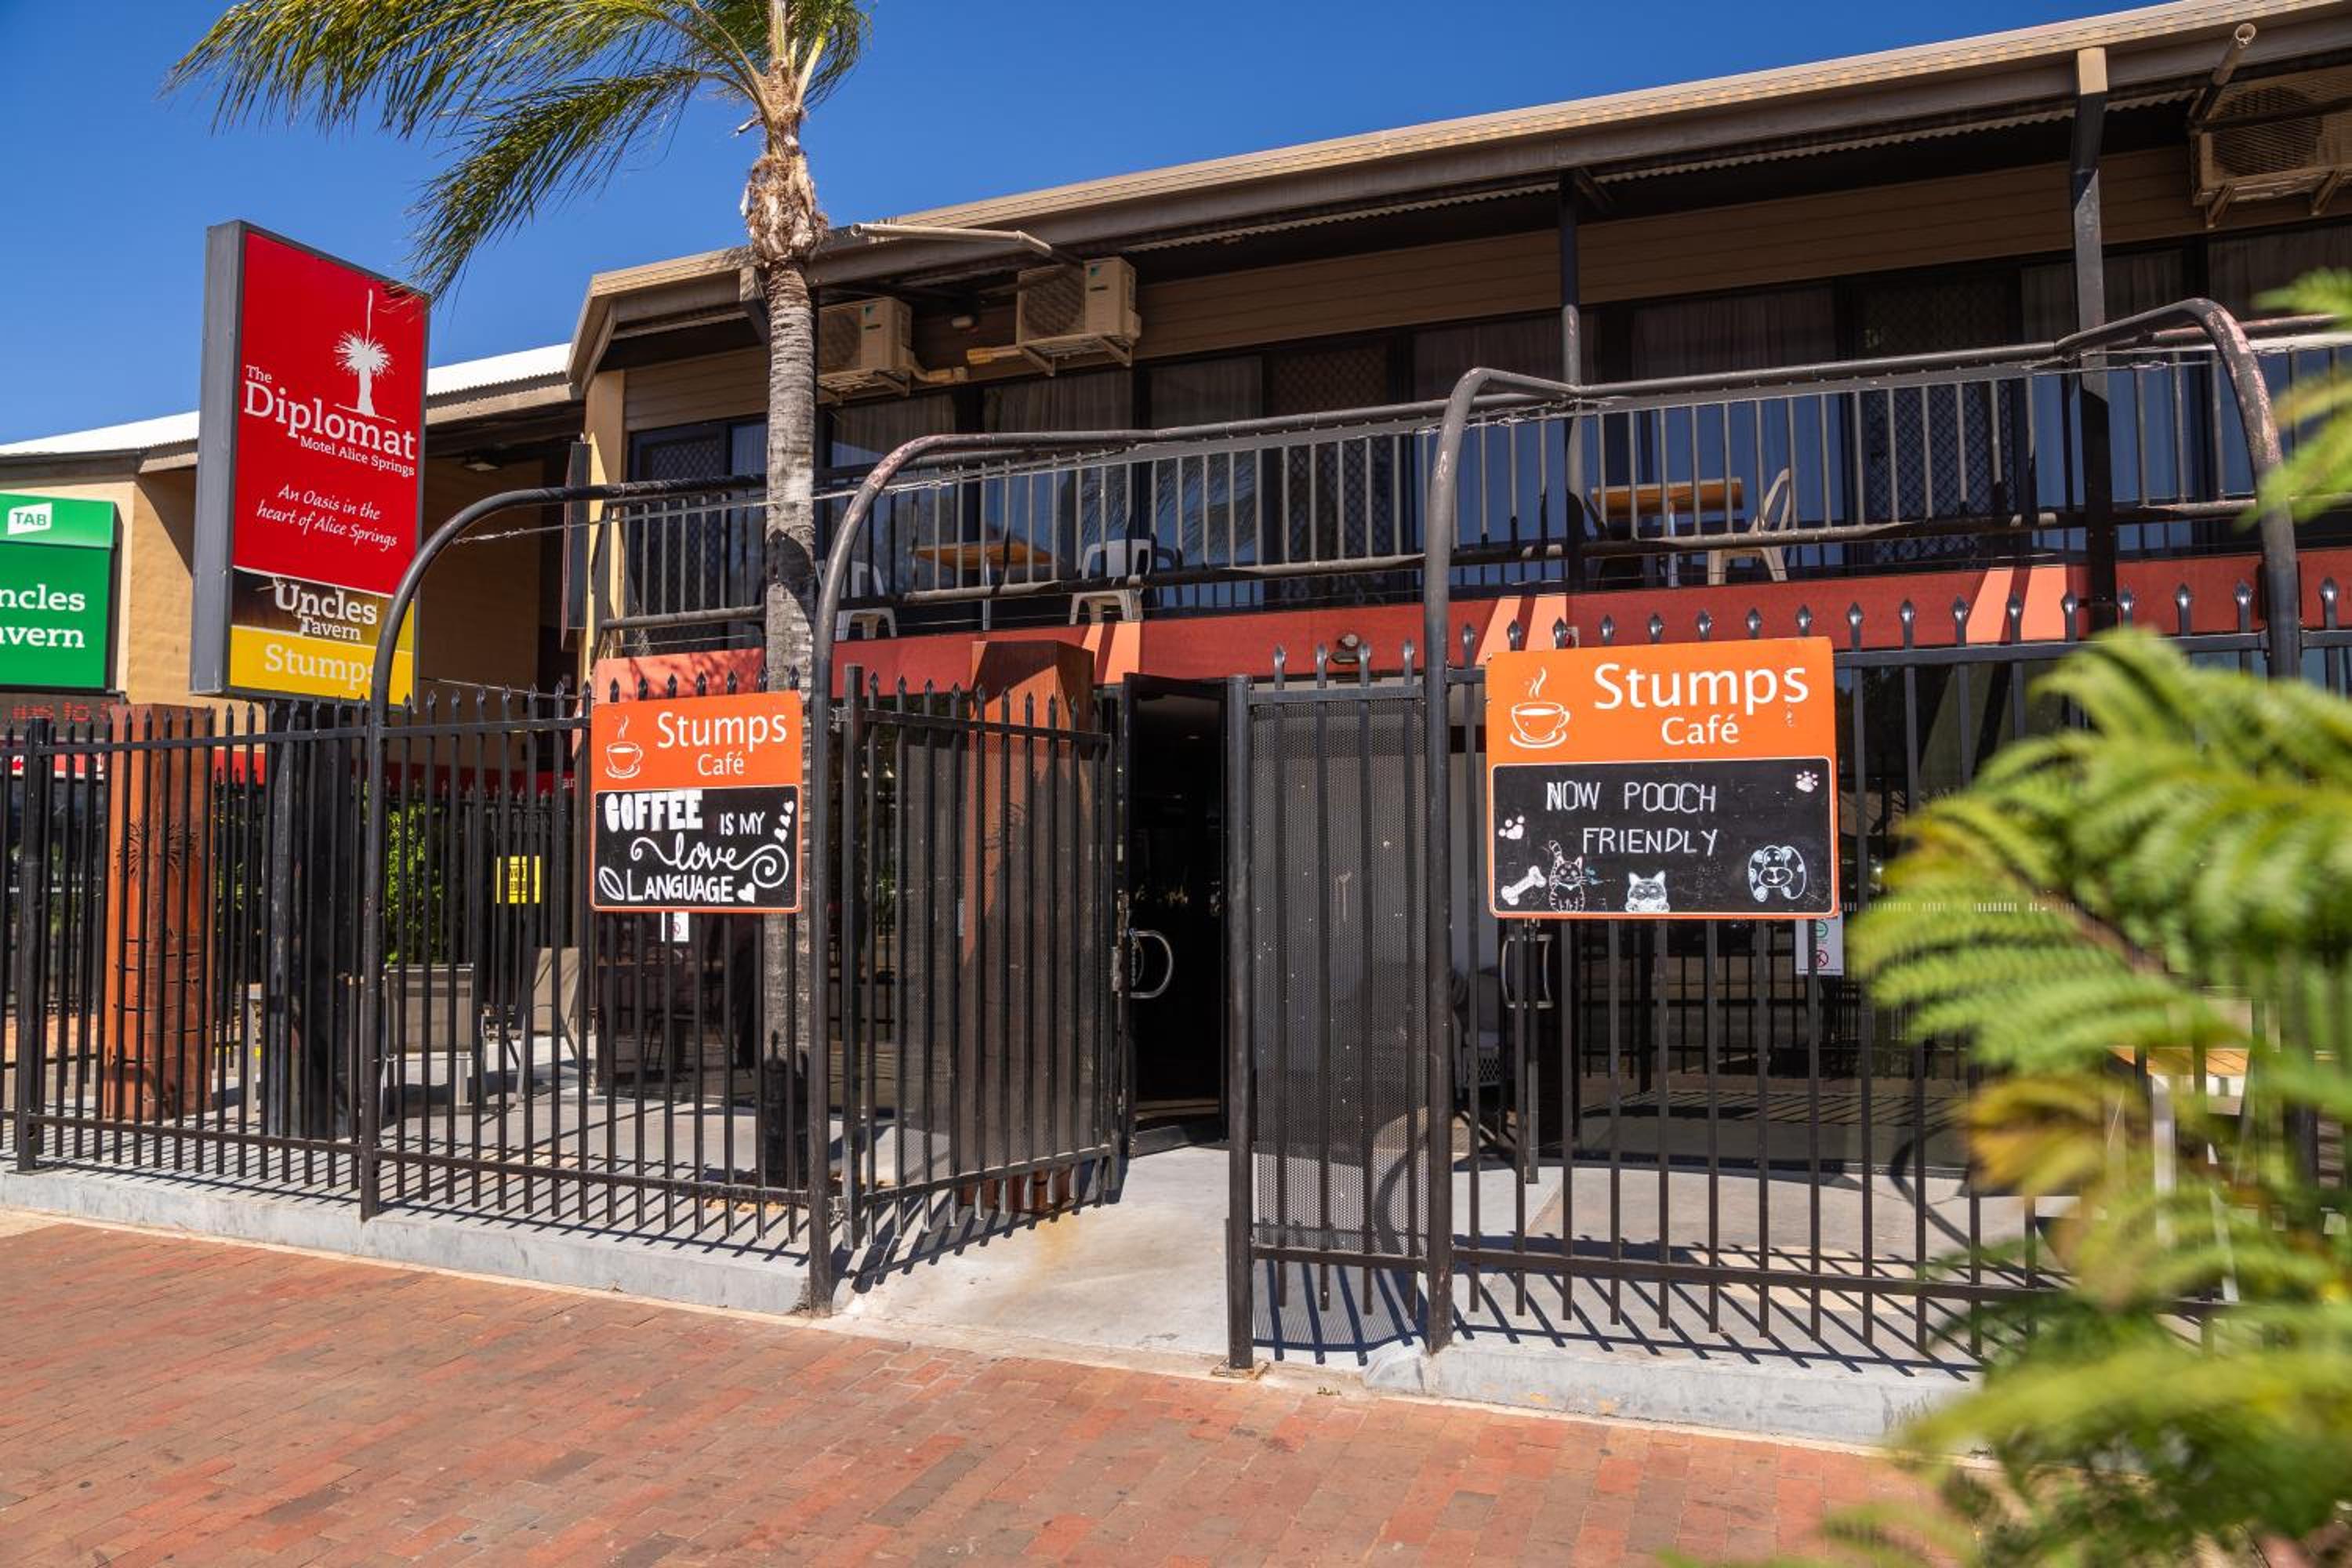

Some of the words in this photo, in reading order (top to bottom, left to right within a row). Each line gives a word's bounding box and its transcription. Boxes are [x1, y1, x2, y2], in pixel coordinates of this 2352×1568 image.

[245, 365, 272, 383] The
[244, 379, 416, 459] Diplomat
[300, 435, 336, 456] Motel
[338, 446, 368, 463] Alice
[371, 455, 415, 477] Springs
[13, 512, 47, 526] TAB
[278, 484, 299, 501] An
[303, 490, 339, 510] Oasis
[343, 499, 356, 515] in
[359, 501, 381, 521] the
[256, 499, 296, 524] heart
[299, 511, 315, 535] of
[314, 516, 346, 535] Alice
[349, 523, 397, 552] Springs
[274, 583, 377, 625] Uncles
[300, 615, 361, 641] Tavern
[1594, 662, 1809, 716] Stumps
[657, 711, 787, 753] Stumps
[1661, 713, 1740, 746] Café
[697, 750, 745, 776] Café
[604, 789, 703, 833] COFFEE
[720, 811, 734, 836] IS
[739, 811, 765, 835] MY
[1546, 781, 1601, 812] NOW
[1624, 781, 1717, 813] POOCH
[1582, 827, 1718, 856] FRIENDLY
[627, 868, 735, 903] LANGUAGE
